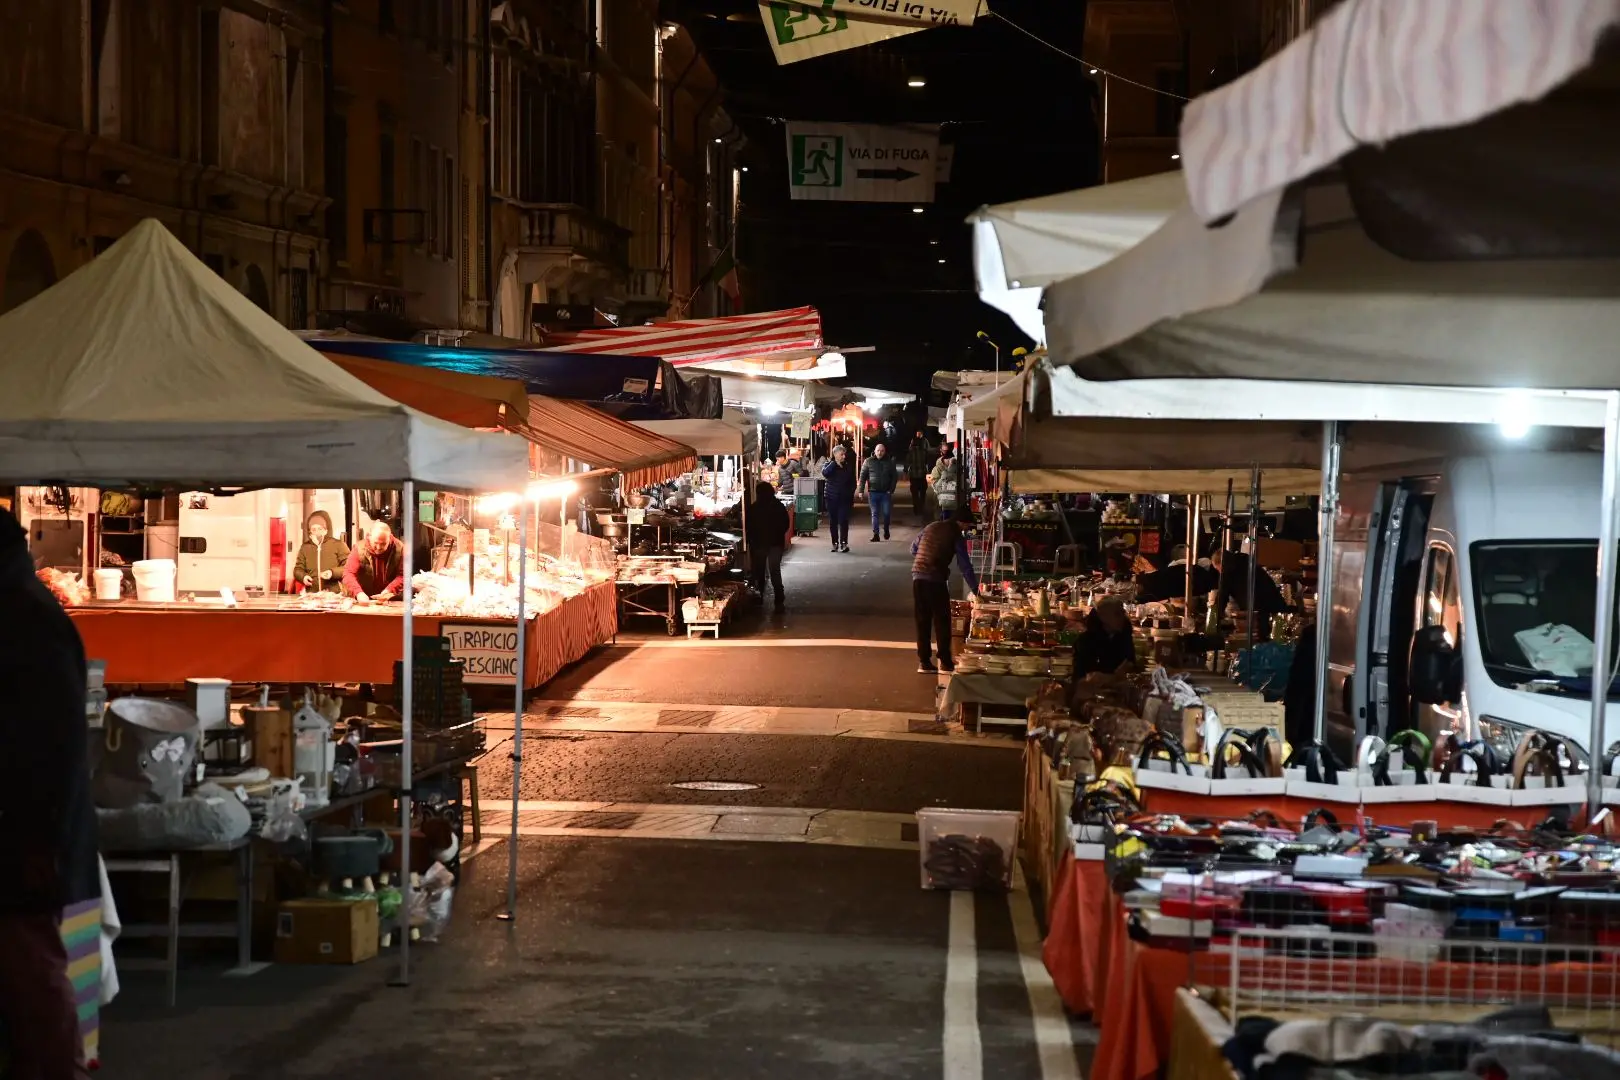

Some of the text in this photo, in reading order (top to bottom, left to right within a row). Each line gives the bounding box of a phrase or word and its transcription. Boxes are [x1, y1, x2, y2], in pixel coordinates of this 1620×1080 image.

[903, 2, 924, 19] DI
[848, 147, 871, 160] VIA
[875, 148, 888, 160] DI
[893, 147, 930, 160] FUGA
[450, 656, 518, 676] RESCIANO
